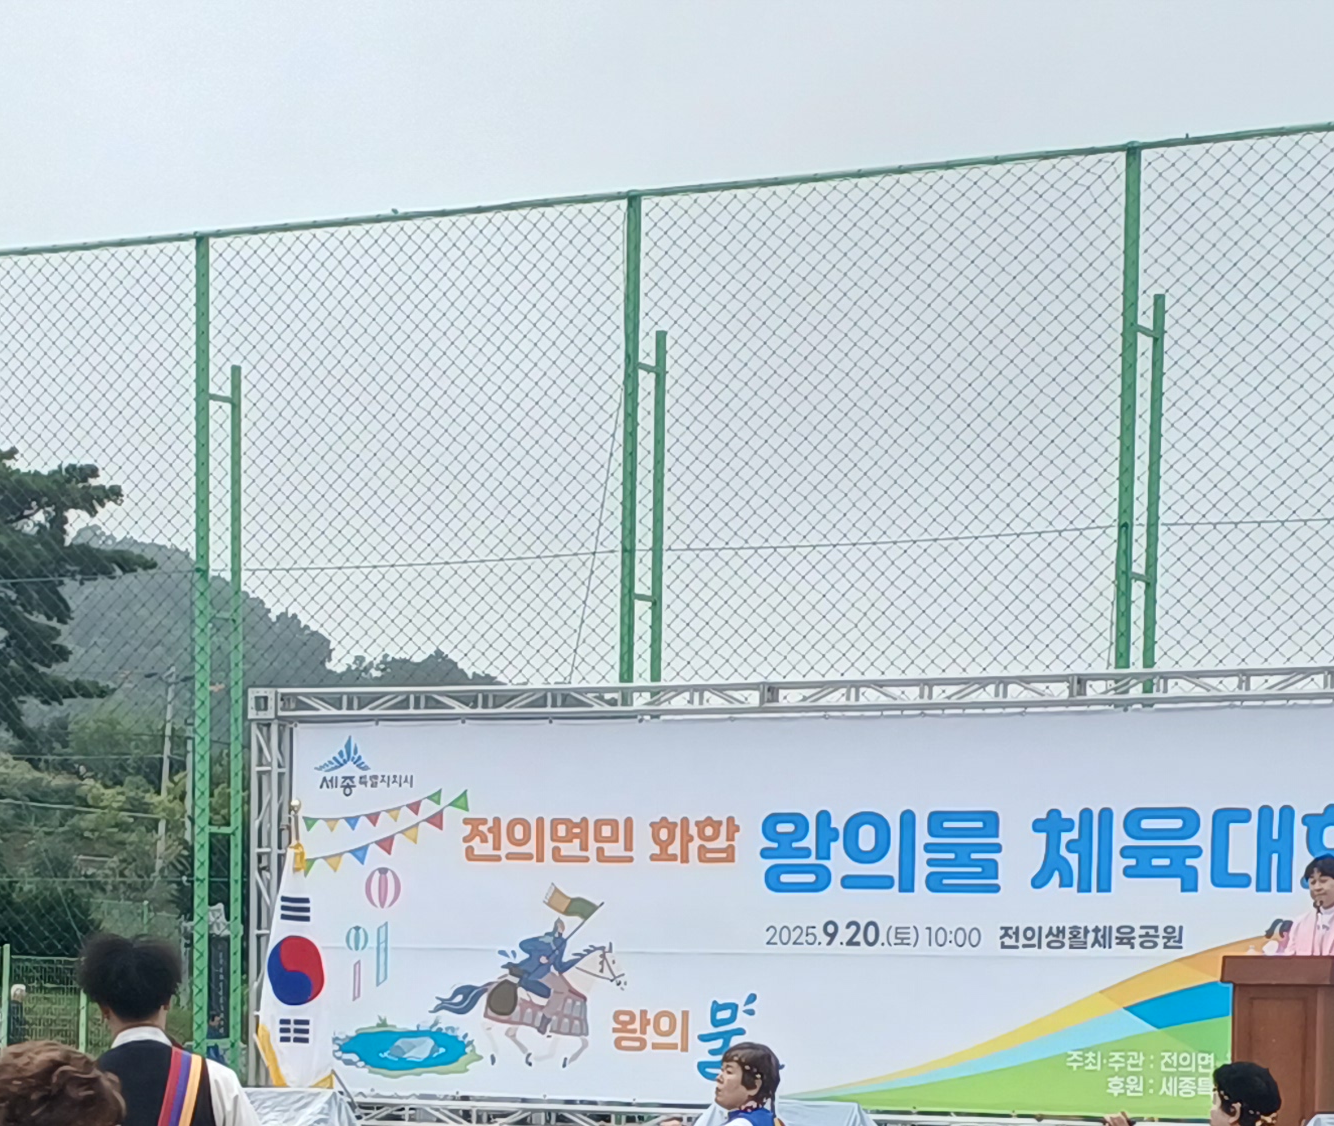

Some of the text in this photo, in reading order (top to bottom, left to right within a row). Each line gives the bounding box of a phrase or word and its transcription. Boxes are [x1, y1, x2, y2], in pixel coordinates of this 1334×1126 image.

[462, 816, 634, 863] 전의면민
[648, 816, 740, 864] 화합
[759, 808, 1003, 894] 왕의물
[765, 920, 1185, 949] 2025.9.20.(토) 10:00 전의생활체육공원
[612, 1009, 690, 1053] 왕의
[1107, 1076, 1144, 1097] 후원
